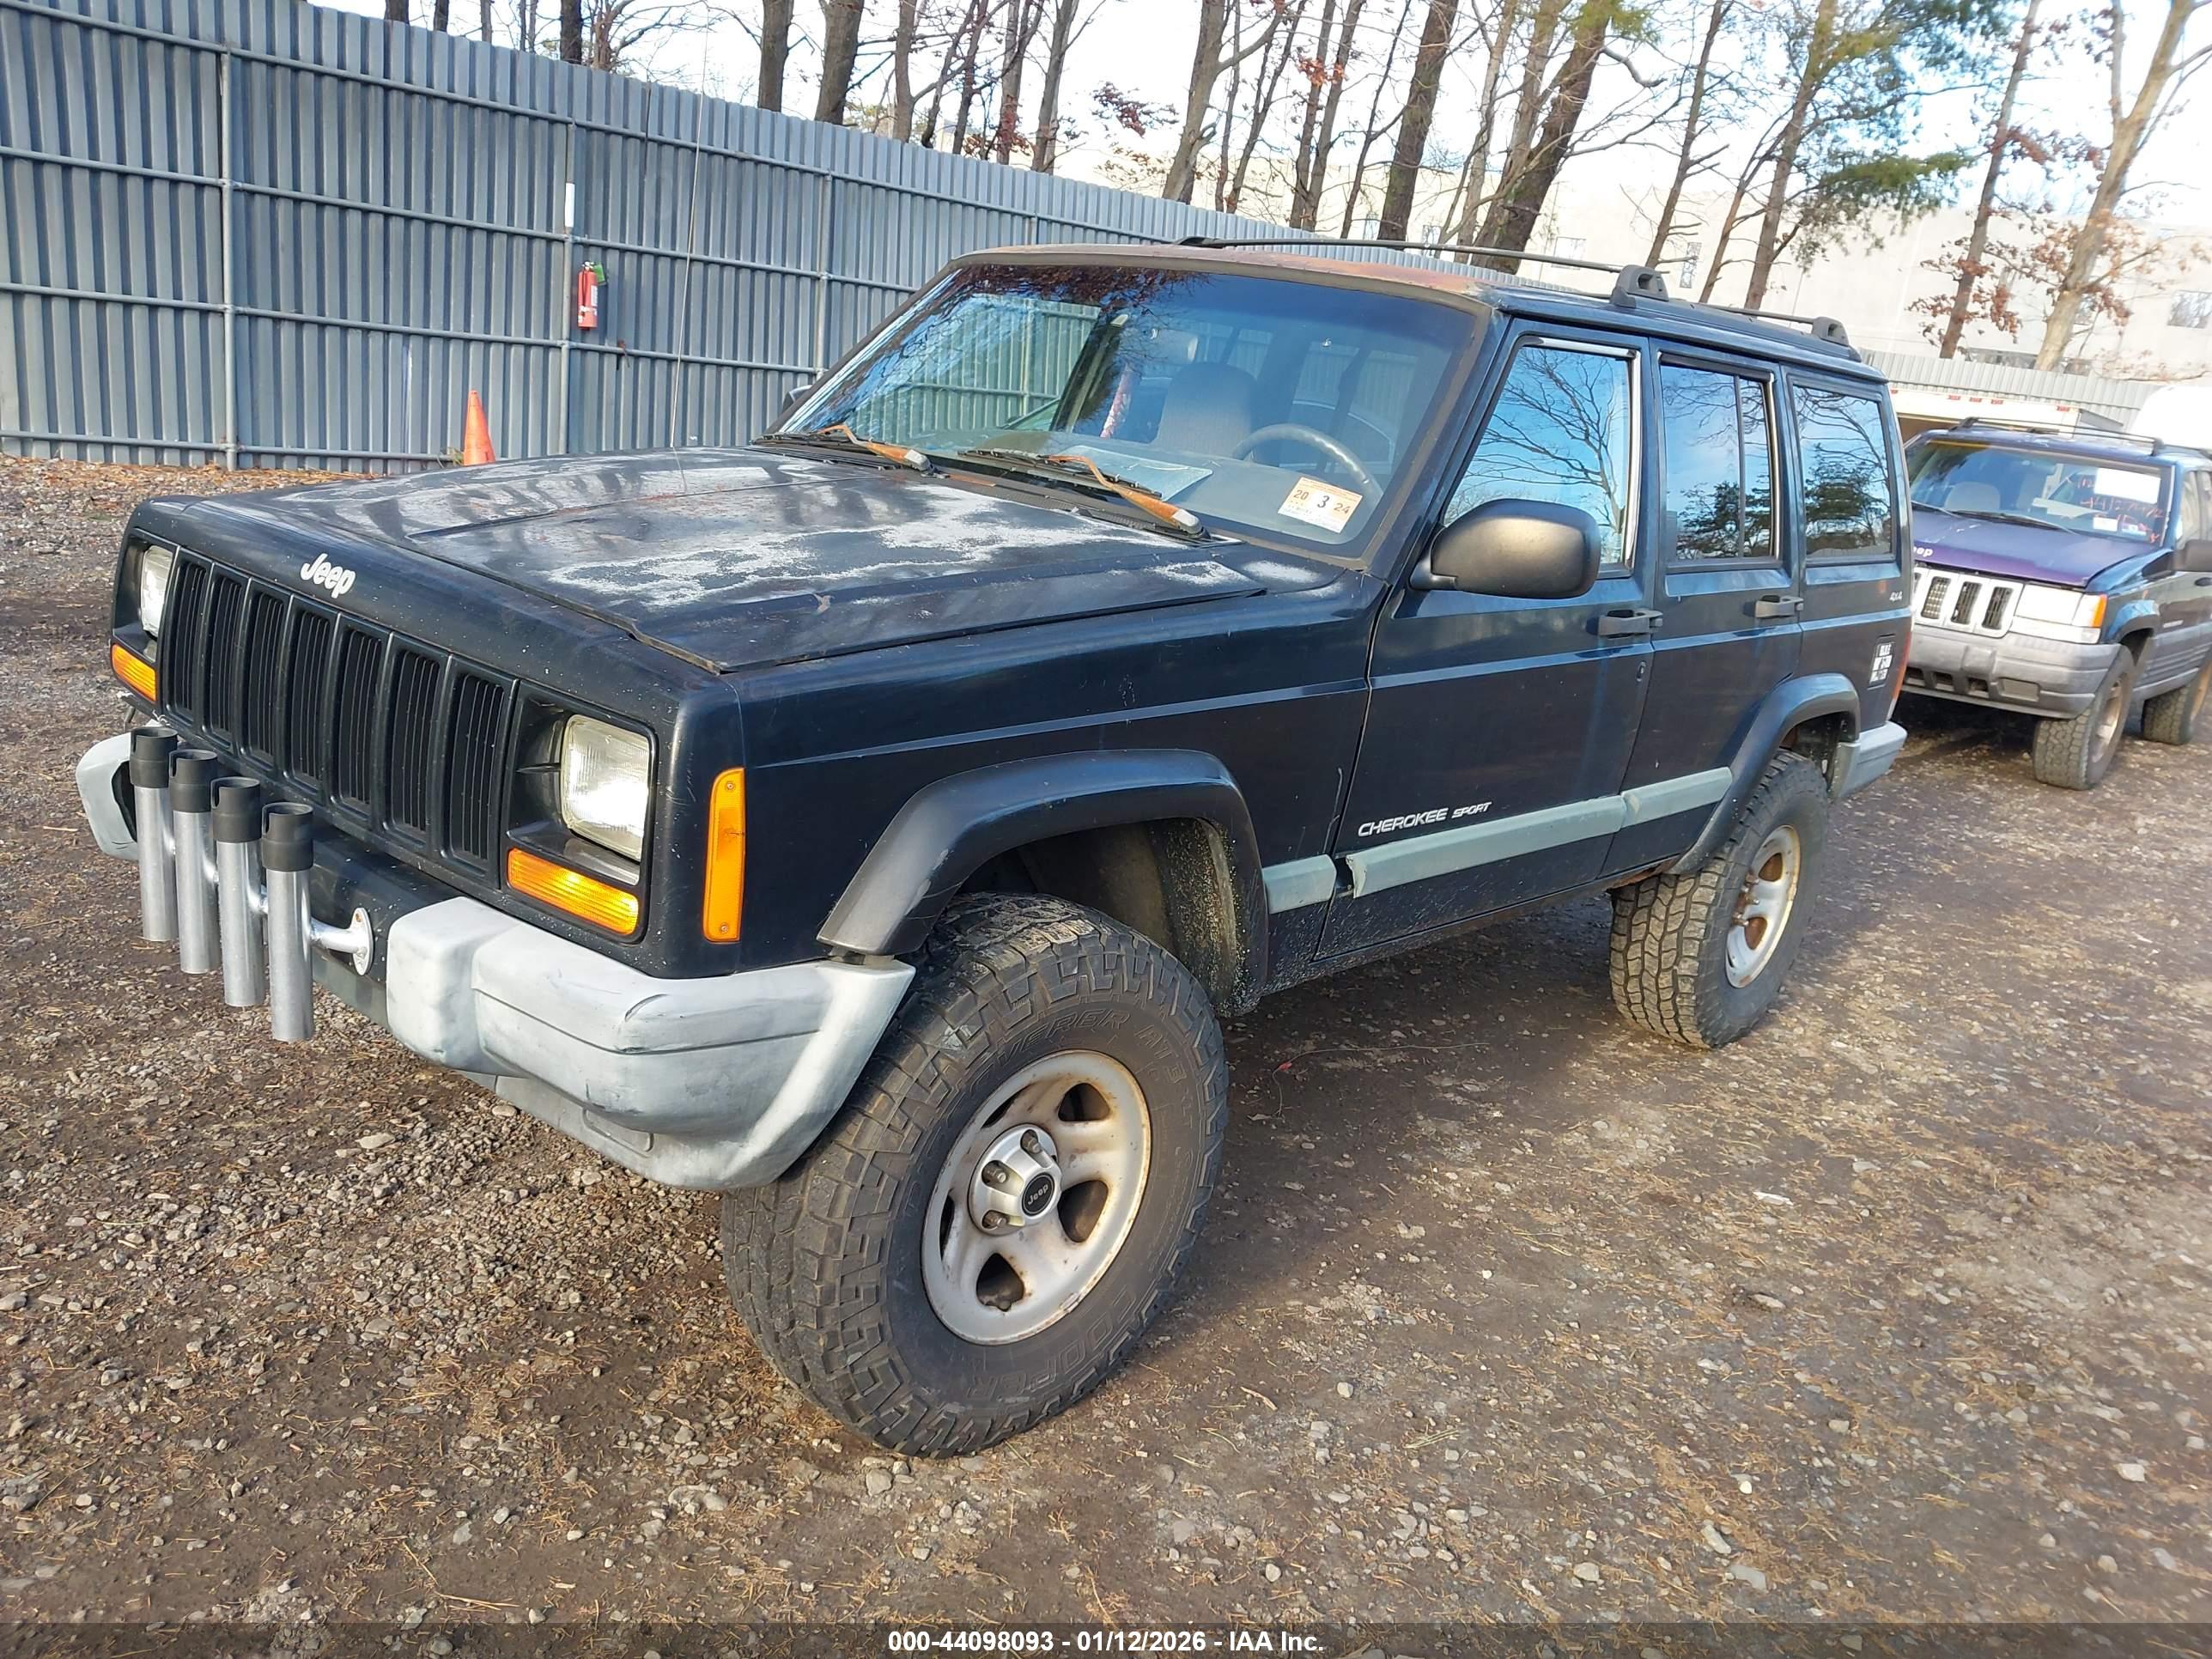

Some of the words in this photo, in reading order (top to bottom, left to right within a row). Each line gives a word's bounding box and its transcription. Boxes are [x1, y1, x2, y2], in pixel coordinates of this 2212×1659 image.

[1293, 489, 1310, 501] 20
[1316, 495, 1330, 508] 3
[1334, 502, 1351, 514] 24
[301, 553, 356, 599] Jeep
[1358, 807, 1449, 837] CHEROKEE
[1451, 801, 1492, 818] SPORT
[1027, 1182, 1049, 1206] Jeep
